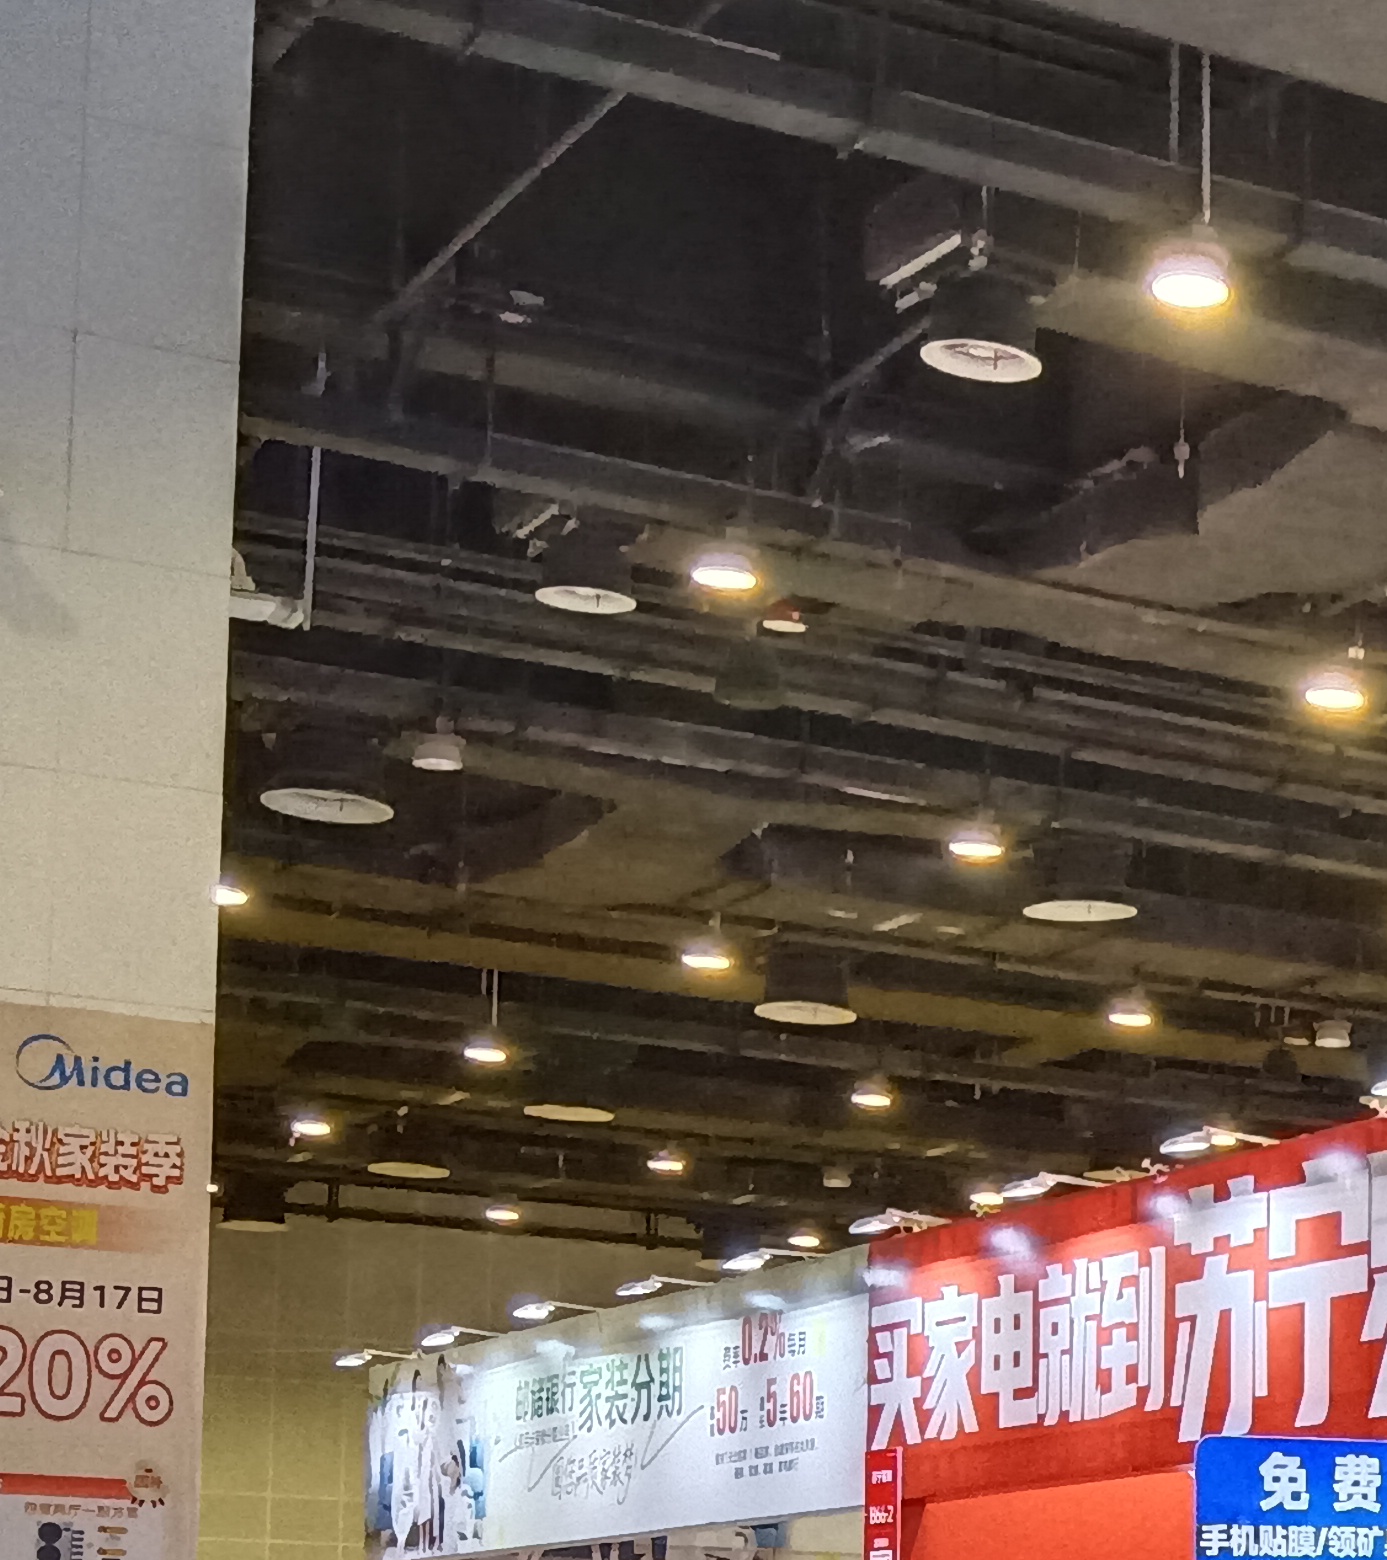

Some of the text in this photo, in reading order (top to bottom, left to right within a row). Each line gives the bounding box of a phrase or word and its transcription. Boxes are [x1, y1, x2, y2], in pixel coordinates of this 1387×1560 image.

[46, 1052, 189, 1097] Midea
[0, 1120, 184, 1194] 秋家装季
[870, 1246, 1165, 1450] 买家电就到
[578, 1346, 684, 1434] 家装分期
[1259, 1451, 1382, 1513] 免费
